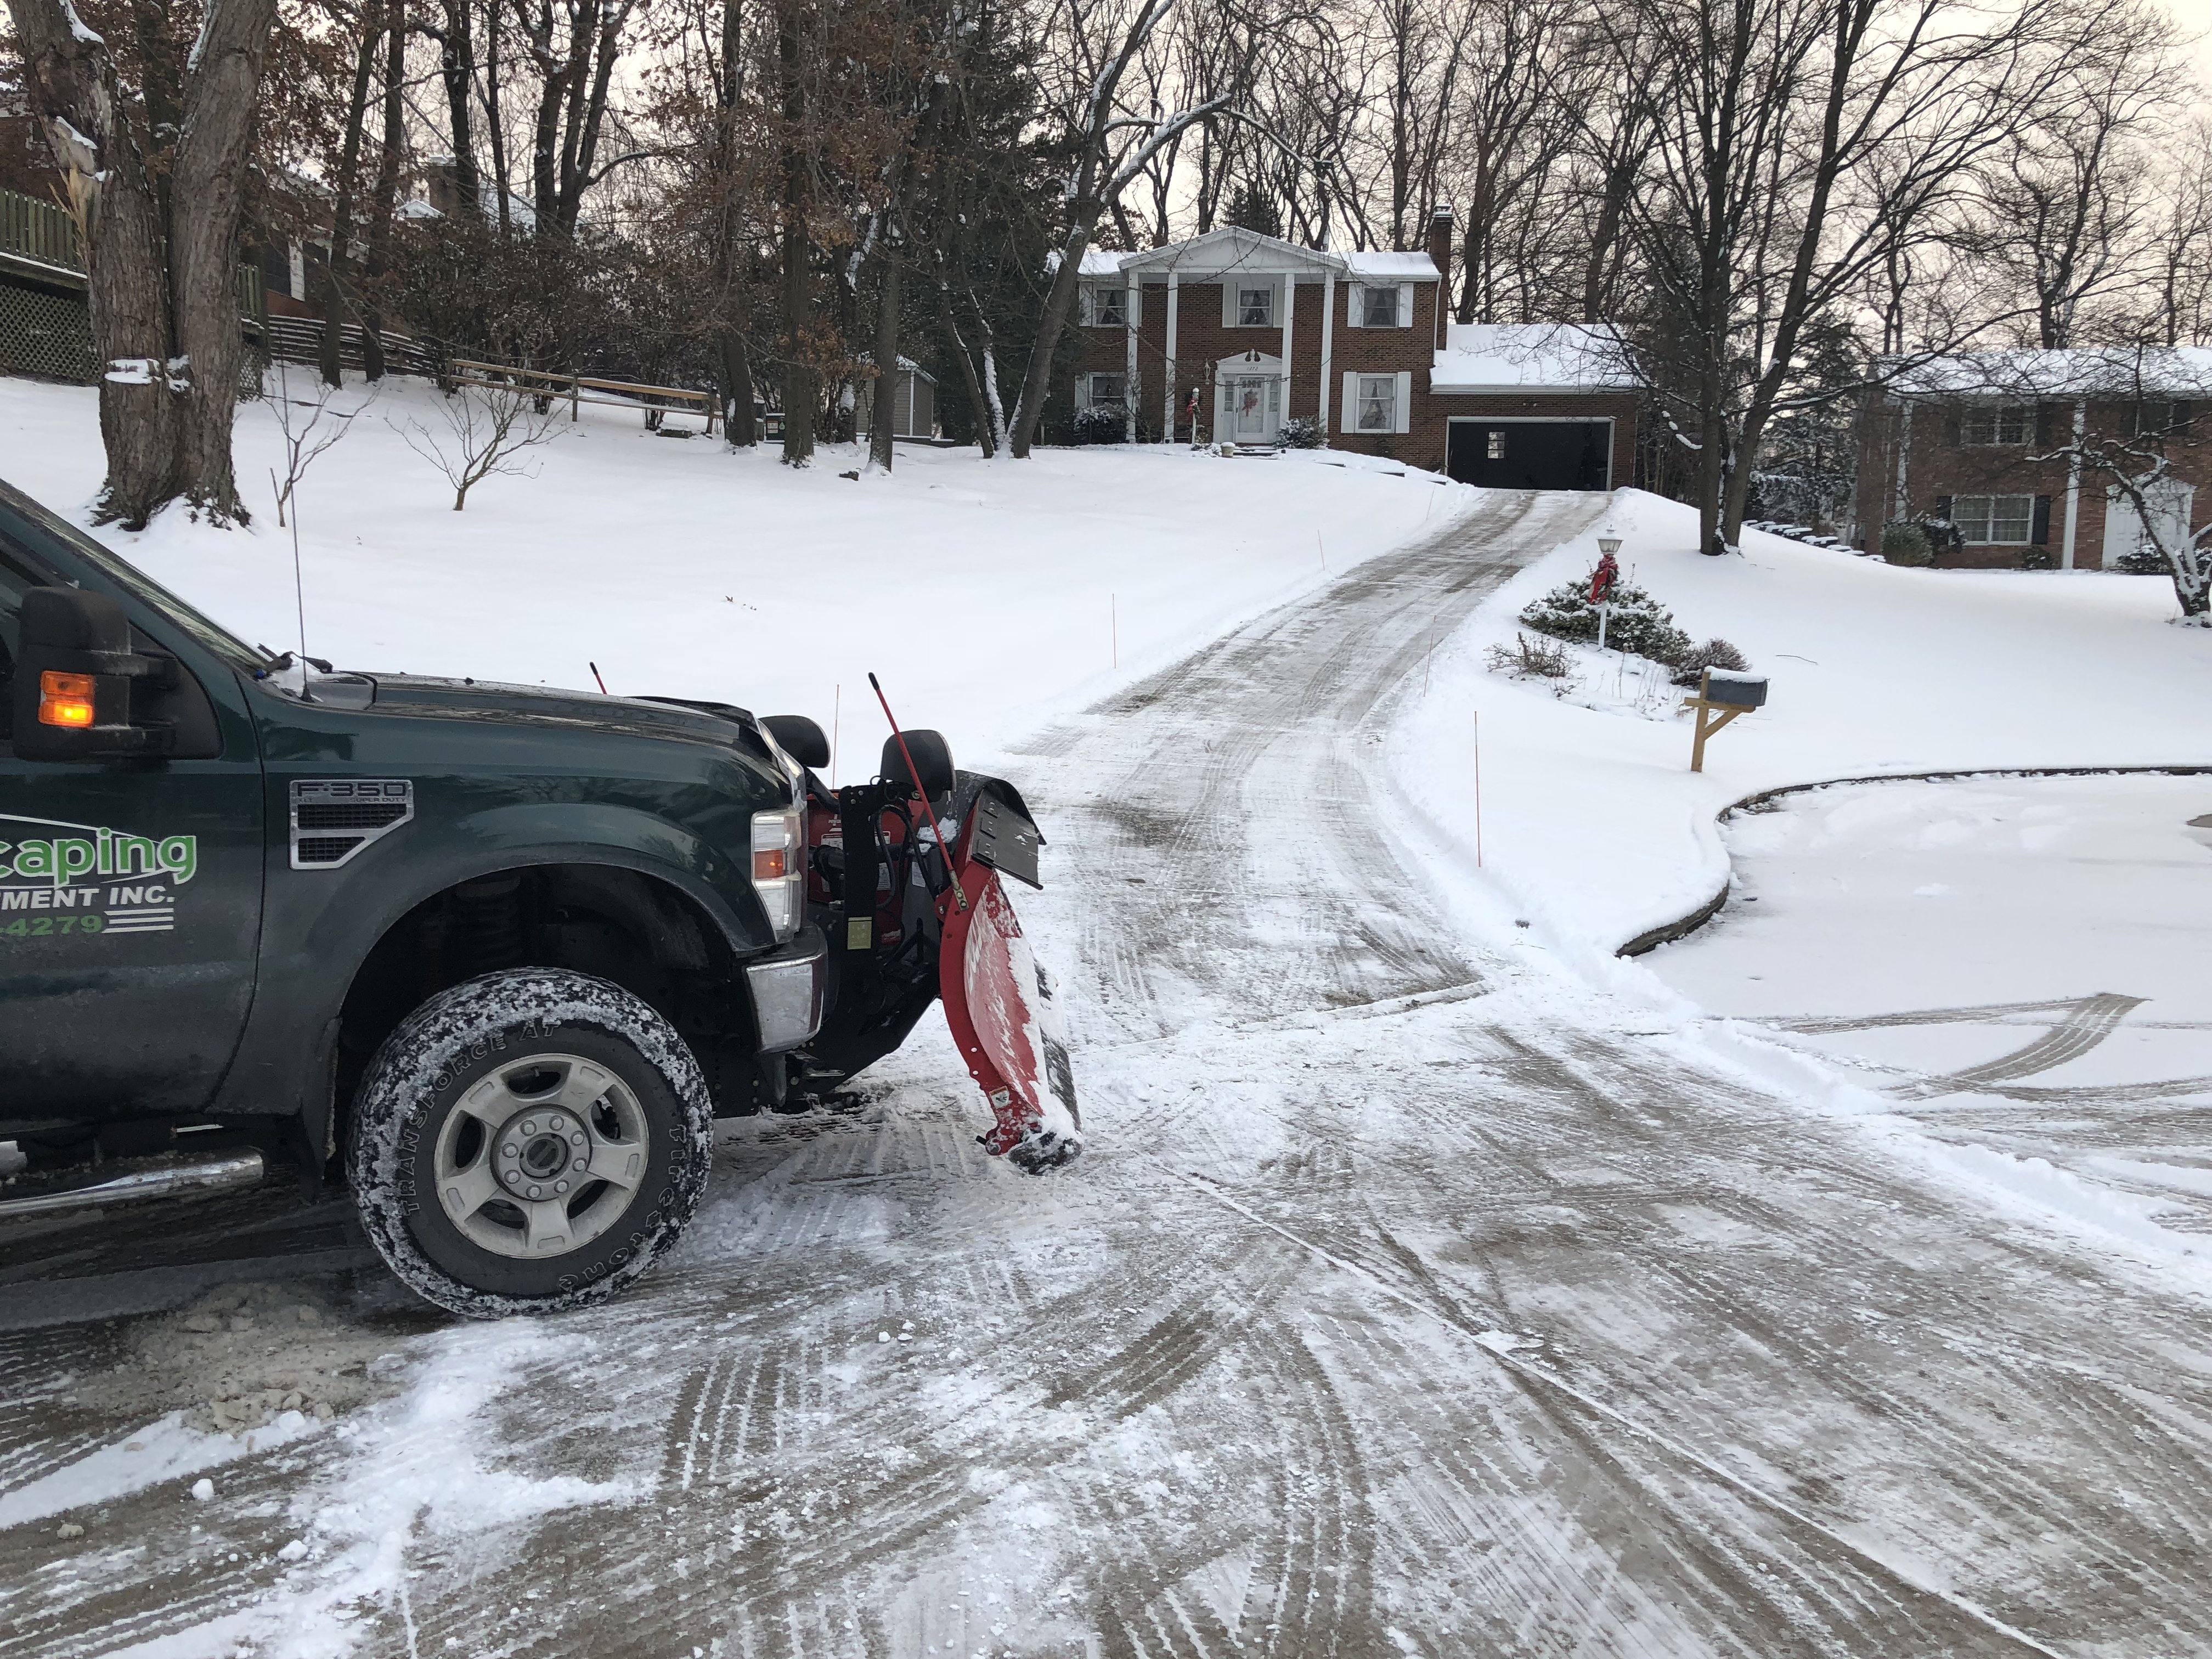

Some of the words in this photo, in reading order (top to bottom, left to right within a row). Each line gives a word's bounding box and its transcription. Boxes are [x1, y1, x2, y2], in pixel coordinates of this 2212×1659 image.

[298, 783, 406, 796] F-350
[0, 889, 99, 910] MENT
[110, 885, 175, 905] INC.
[398, 1035, 507, 1216] TRANSFORCE
